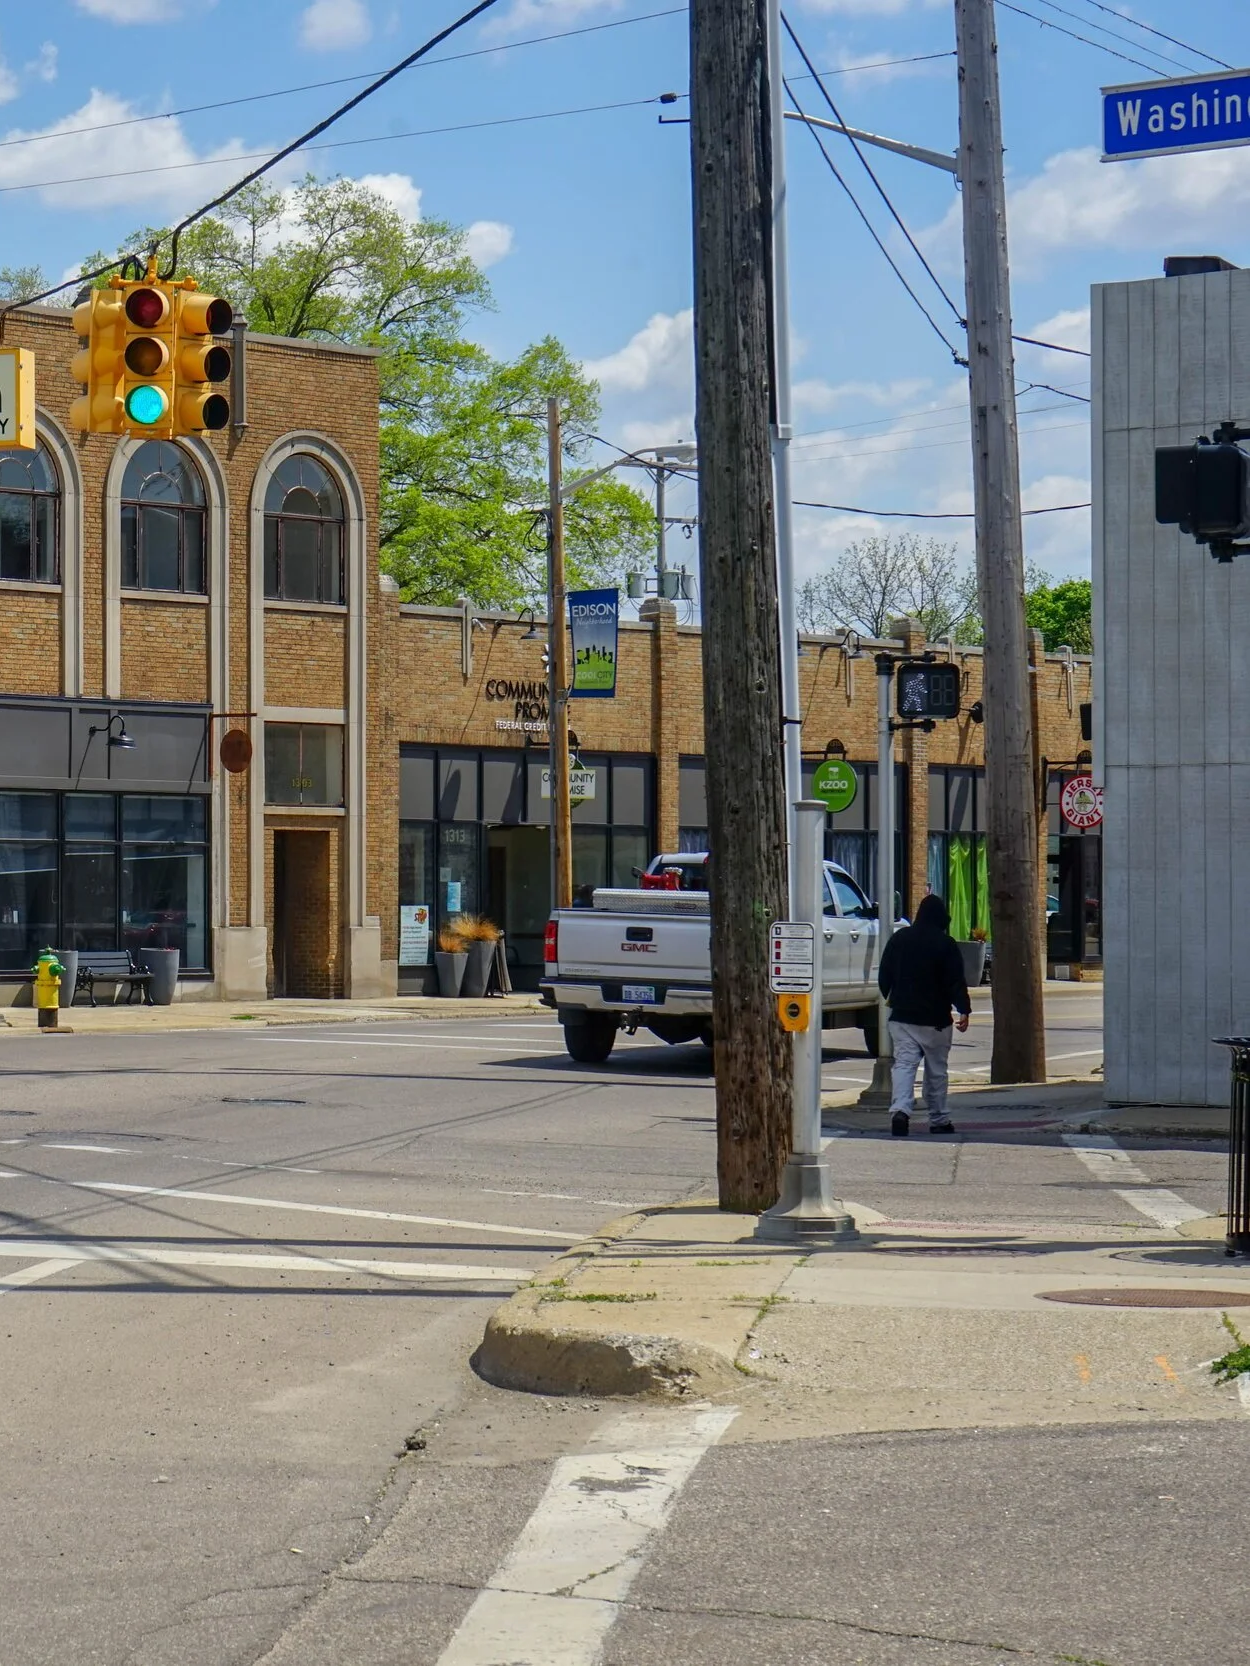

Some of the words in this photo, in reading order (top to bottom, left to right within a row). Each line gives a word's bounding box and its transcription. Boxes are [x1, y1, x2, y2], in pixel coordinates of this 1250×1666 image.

[1116, 89, 1250, 137] Washin
[571, 603, 616, 617] EDISON
[495, 720, 522, 730] FEDERAL
[524, 722, 546, 732] CREDIT
[819, 780, 848, 789] KZOO
[1066, 779, 1103, 798] JERSY
[1066, 808, 1102, 825] GIANT
[445, 829, 465, 842] 1313
[621, 943, 657, 953] GMC
